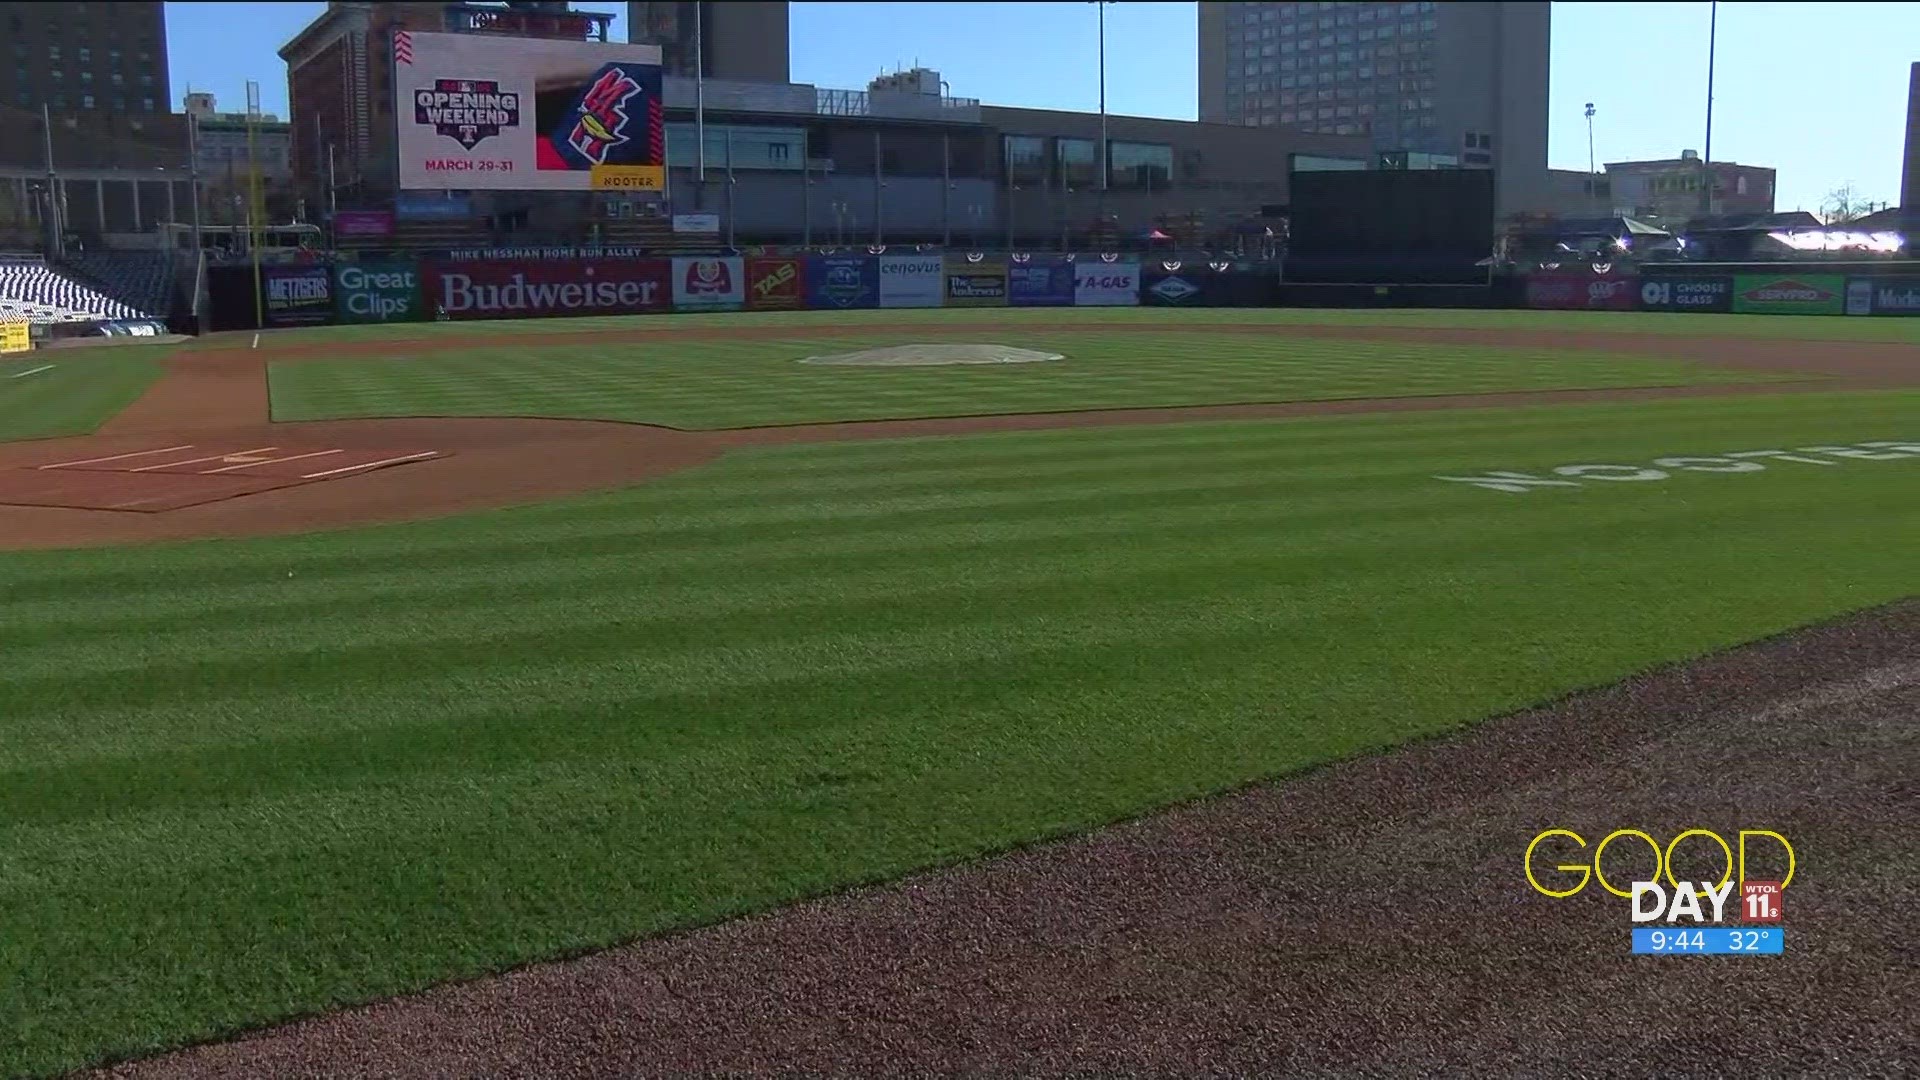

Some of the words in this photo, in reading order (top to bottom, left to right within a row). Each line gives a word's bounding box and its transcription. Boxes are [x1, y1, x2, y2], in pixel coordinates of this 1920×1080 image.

[418, 92, 517, 111] OPENING
[426, 107, 509, 125] WEEKEND
[425, 160, 473, 171] MARCH
[478, 161, 513, 172] 29-31
[451, 250, 478, 260] MIKE
[543, 249, 575, 258] HOME
[579, 248, 602, 258] RUN
[606, 248, 642, 257] ALLEY
[340, 268, 415, 289] Great
[950, 276, 968, 286] The
[1085, 276, 1131, 289] A-GAS
[441, 266, 659, 311] Budweiser
[1676, 283, 1725, 293] CHOOSE
[348, 293, 409, 320] Clips
[1676, 295, 1713, 305] GLASS
